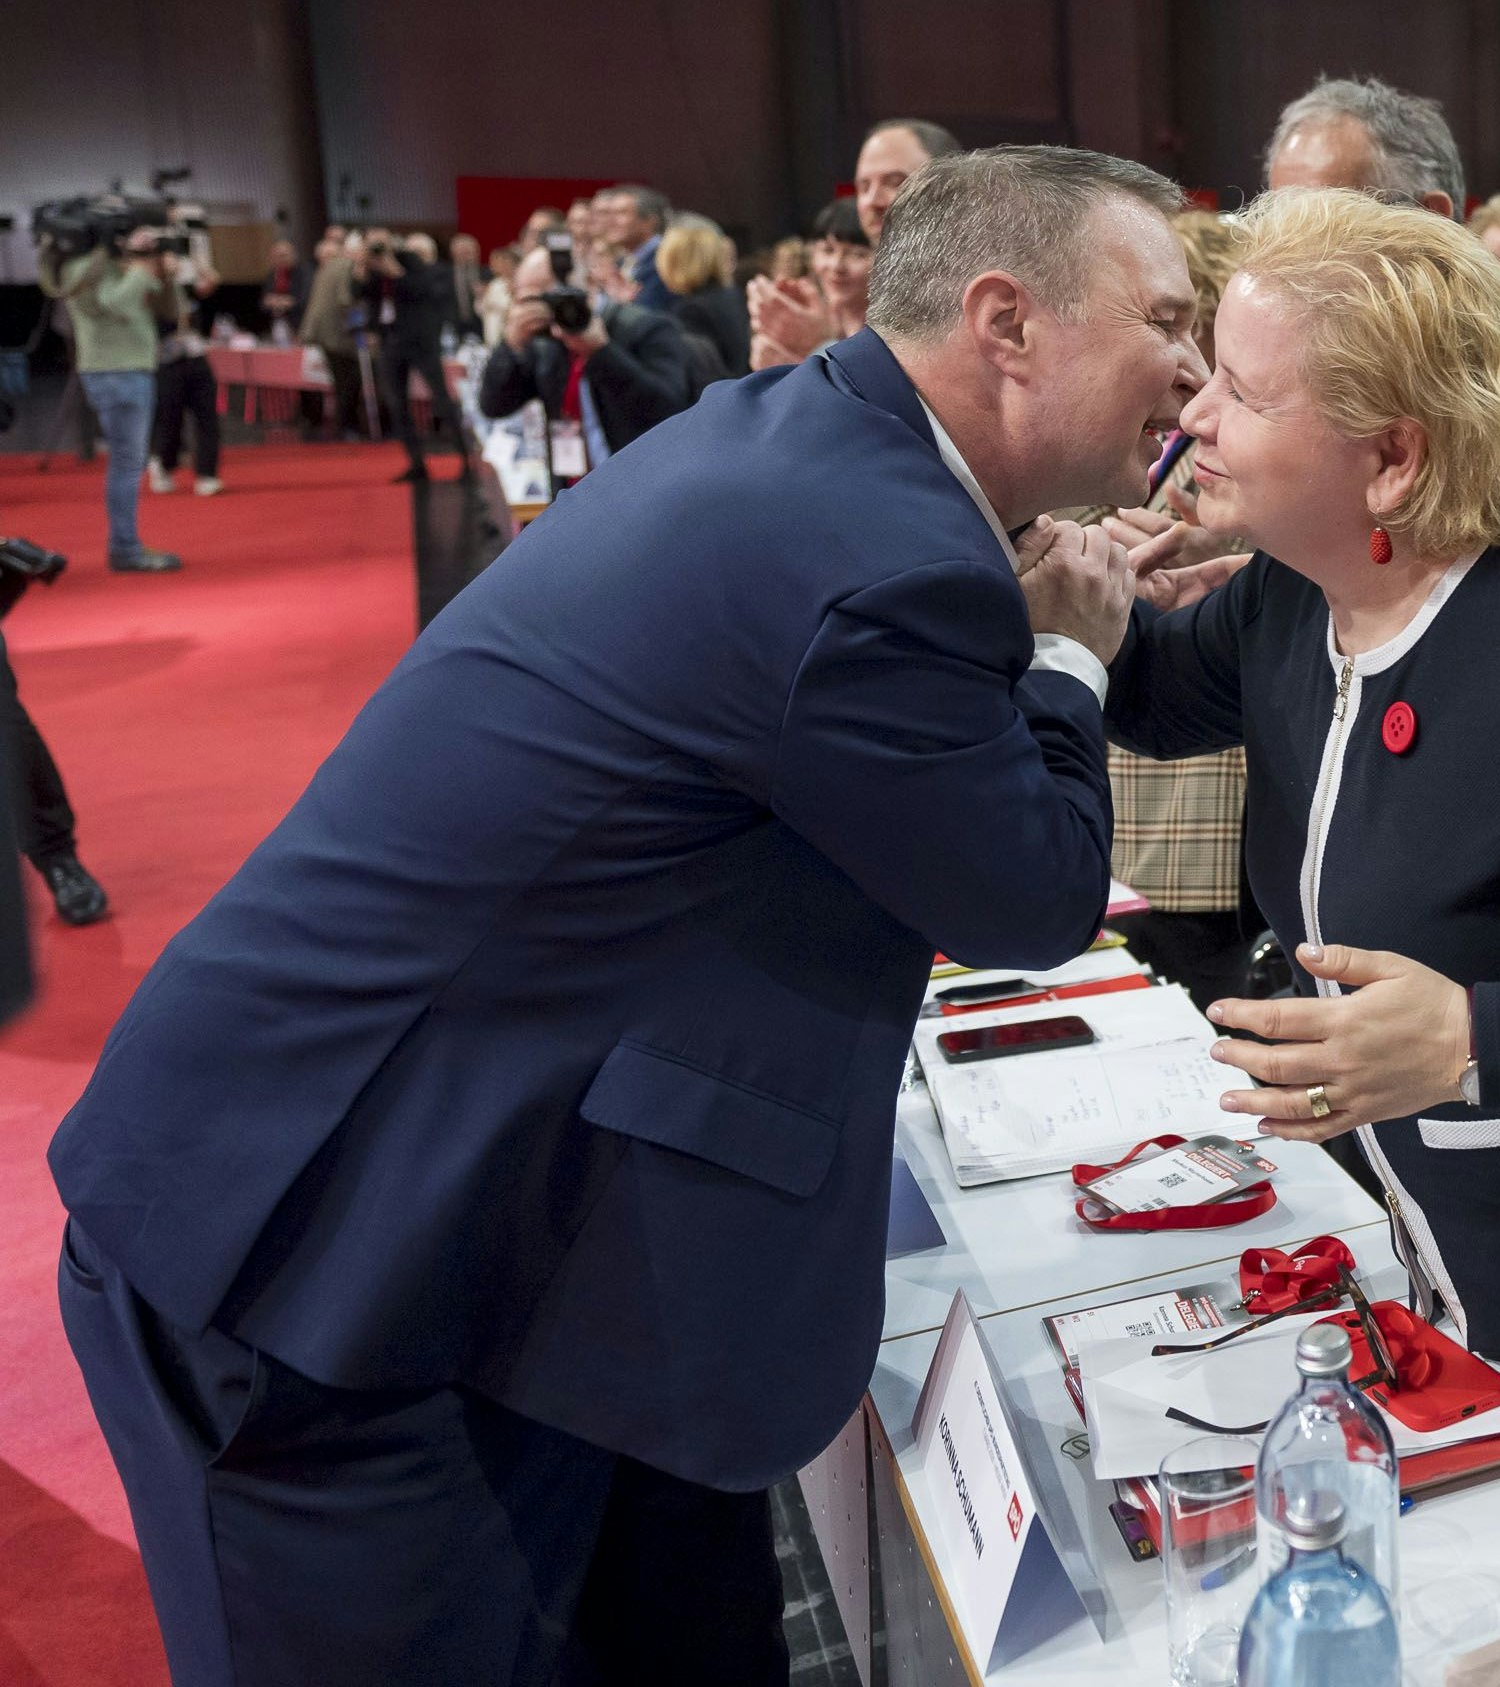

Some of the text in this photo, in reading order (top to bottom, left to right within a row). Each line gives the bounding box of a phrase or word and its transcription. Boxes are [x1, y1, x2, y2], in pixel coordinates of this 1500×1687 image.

[1187, 1153, 1232, 1178] DELEGIERT
[1256, 1159, 1275, 1172] SPÖ
[938, 1412, 985, 1561] KORINNA SCHUMANN
